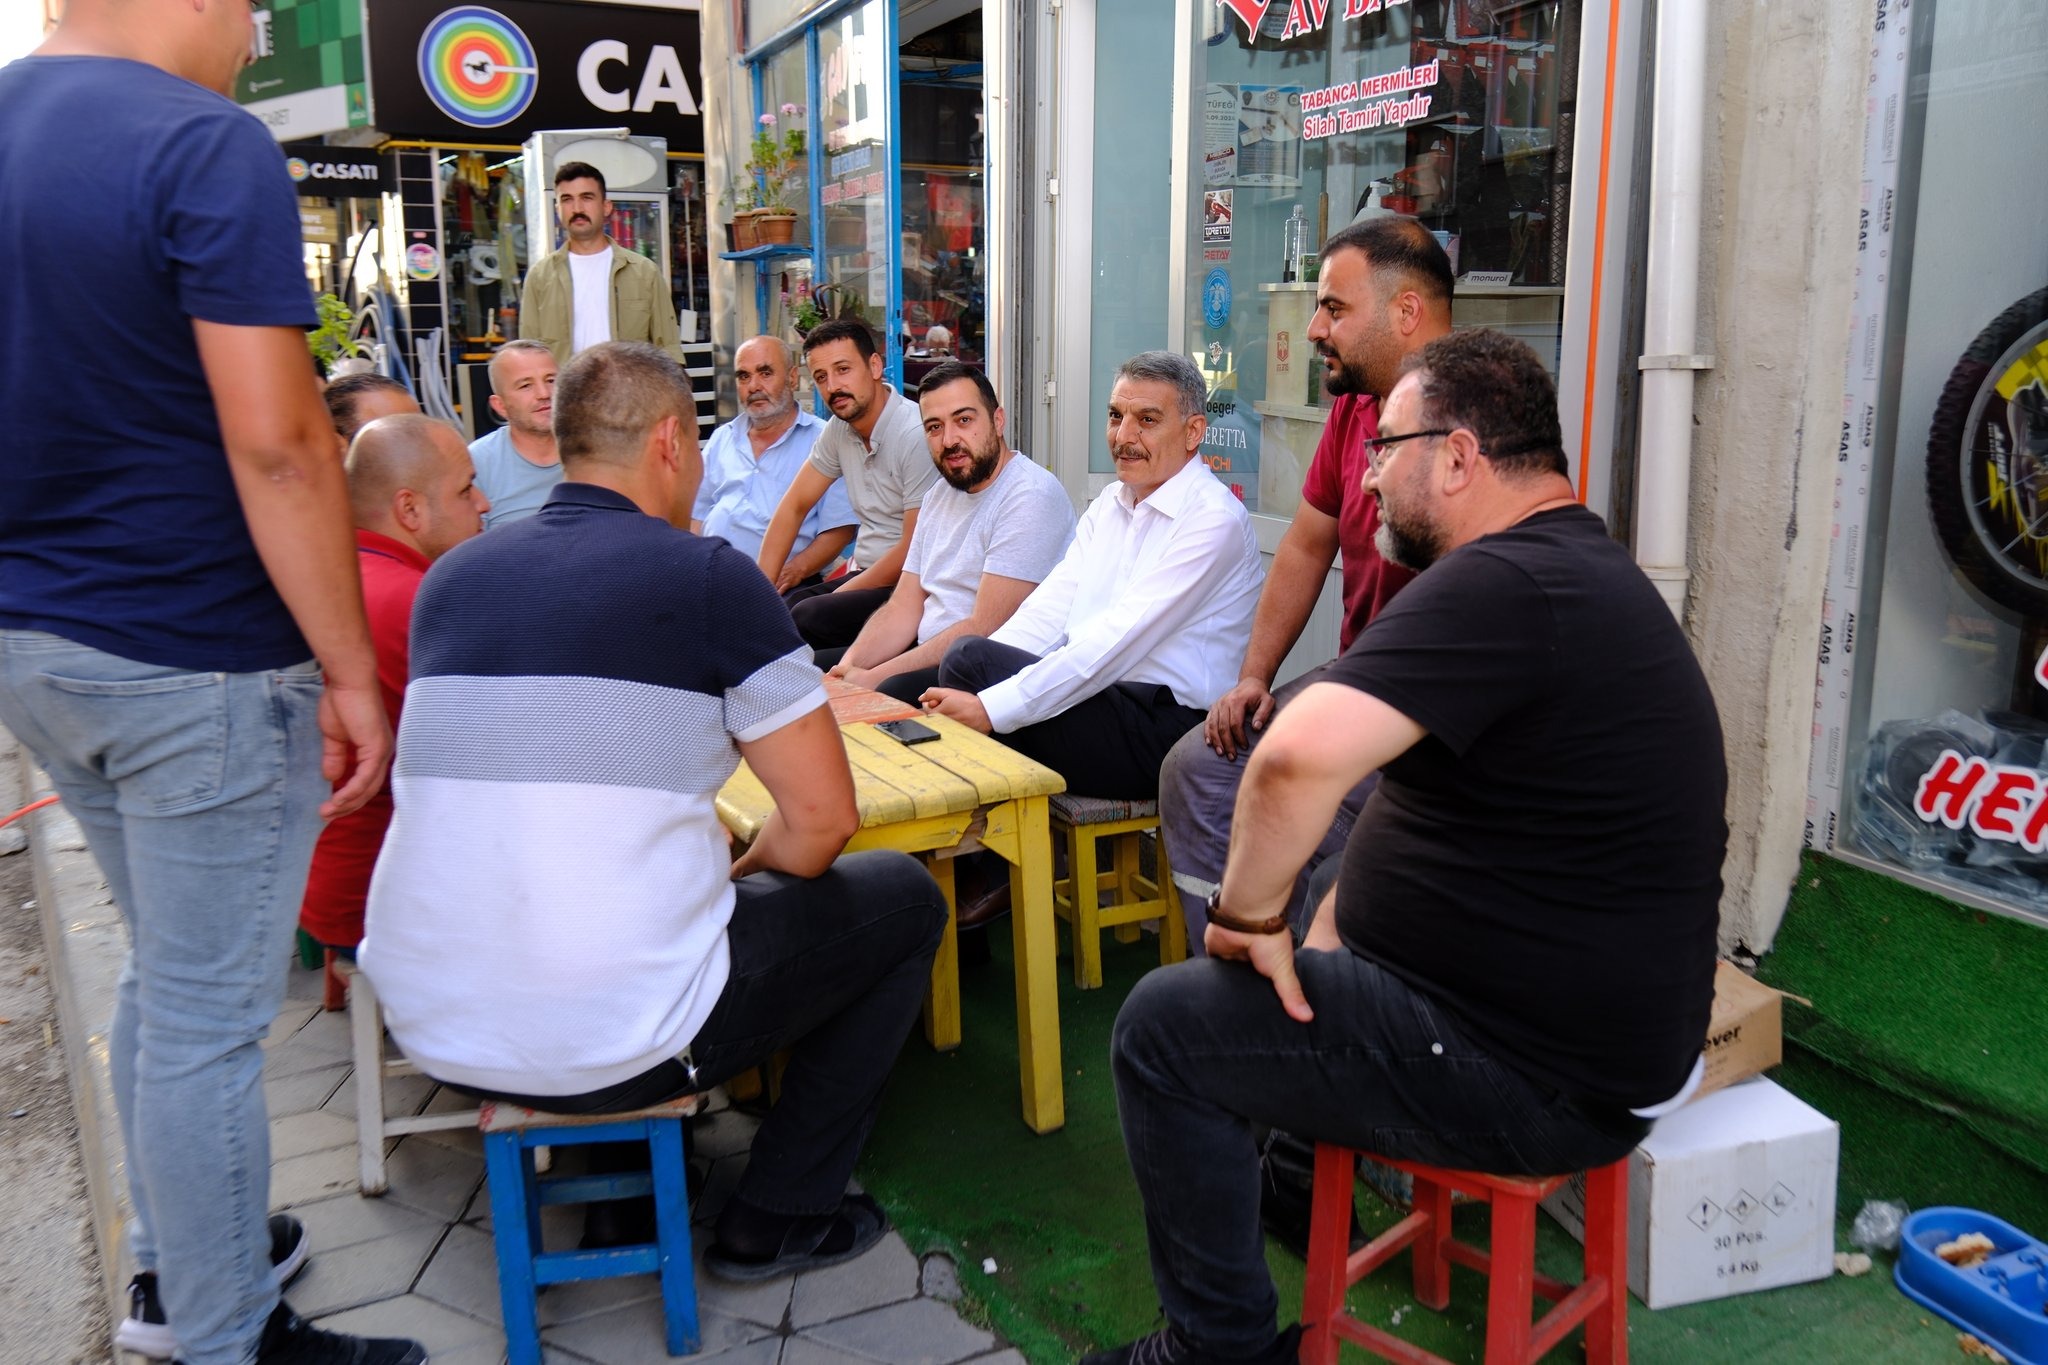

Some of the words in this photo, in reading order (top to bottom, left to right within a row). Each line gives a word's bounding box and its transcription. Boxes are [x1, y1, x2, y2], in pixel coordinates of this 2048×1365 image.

[577, 39, 703, 116] CA
[1300, 83, 1358, 112] TABANCA
[1361, 60, 1438, 98] MERMİLERİ
[1304, 113, 1336, 139] Silah
[1338, 102, 1381, 131] Tamiri
[1383, 94, 1431, 127] Yapılır
[309, 162, 379, 181] CASATI
[1202, 455, 1231, 471] NCHI
